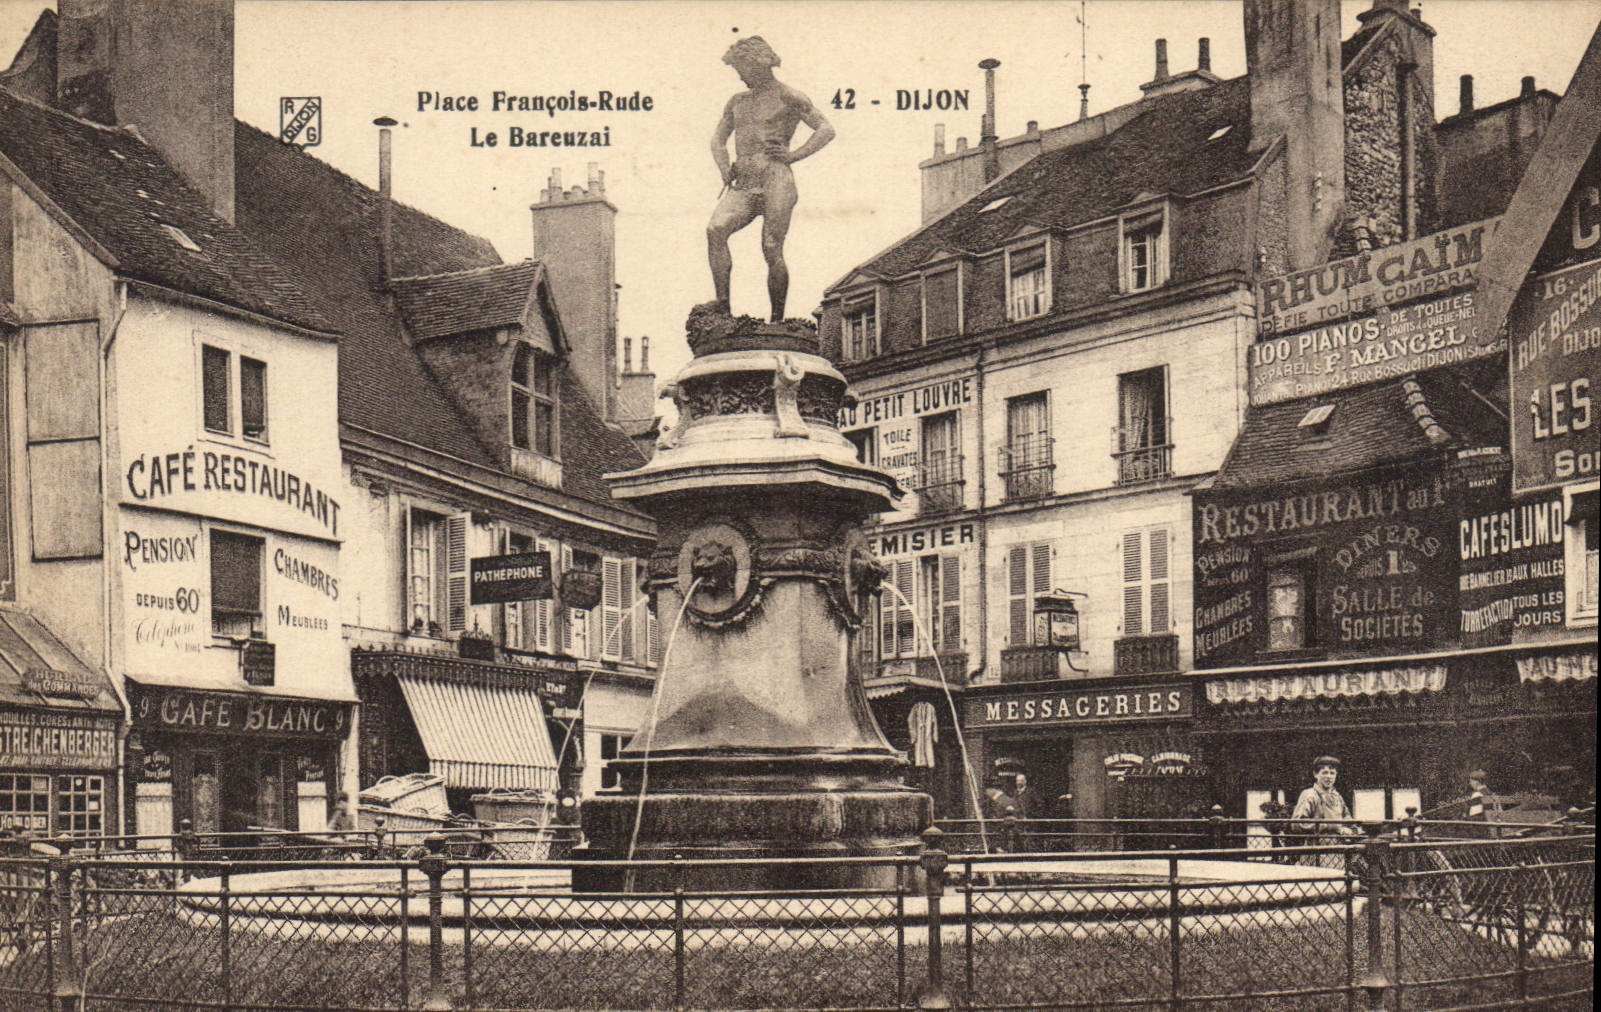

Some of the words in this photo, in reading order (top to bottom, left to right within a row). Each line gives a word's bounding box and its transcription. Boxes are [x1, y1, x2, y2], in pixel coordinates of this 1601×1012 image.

[1259, 249, 1373, 318] RHUM
[1542, 276, 1568, 301] 16
[1317, 292, 1377, 320] TOUTE
[1390, 310, 1408, 324] DE
[1413, 293, 1474, 318] TOUTES
[1252, 339, 1291, 368] 100
[1426, 347, 1463, 369] DIJON
[1517, 320, 1548, 372] RUE
[838, 406, 857, 429] AU
[863, 394, 905, 424] PETIT
[912, 378, 972, 415] LOUVRE
[1530, 377, 1591, 440] LES
[883, 428, 912, 446] TOILE
[126, 445, 197, 500] CAFÉ
[203, 451, 341, 536] RESTAURANT
[1198, 480, 1402, 545] RESTAURANT
[124, 530, 199, 573] PENSION
[274, 547, 340, 602] CHAMBRES
[1230, 568, 1249, 584] 60
[1512, 563, 1529, 581] AUX
[1530, 558, 1565, 580] HALLES
[136, 592, 175, 609] DEPUIS
[175, 586, 200, 614] 60
[1331, 583, 1403, 619] SALLE
[1513, 593, 1540, 609] TOUS
[1541, 590, 1565, 606] LES
[1513, 610, 1562, 628] JOURS
[139, 696, 149, 719] 9
[242, 694, 327, 733] BLANC
[335, 709, 345, 731] 9
[985, 691, 1182, 723] MESSAGERIES
